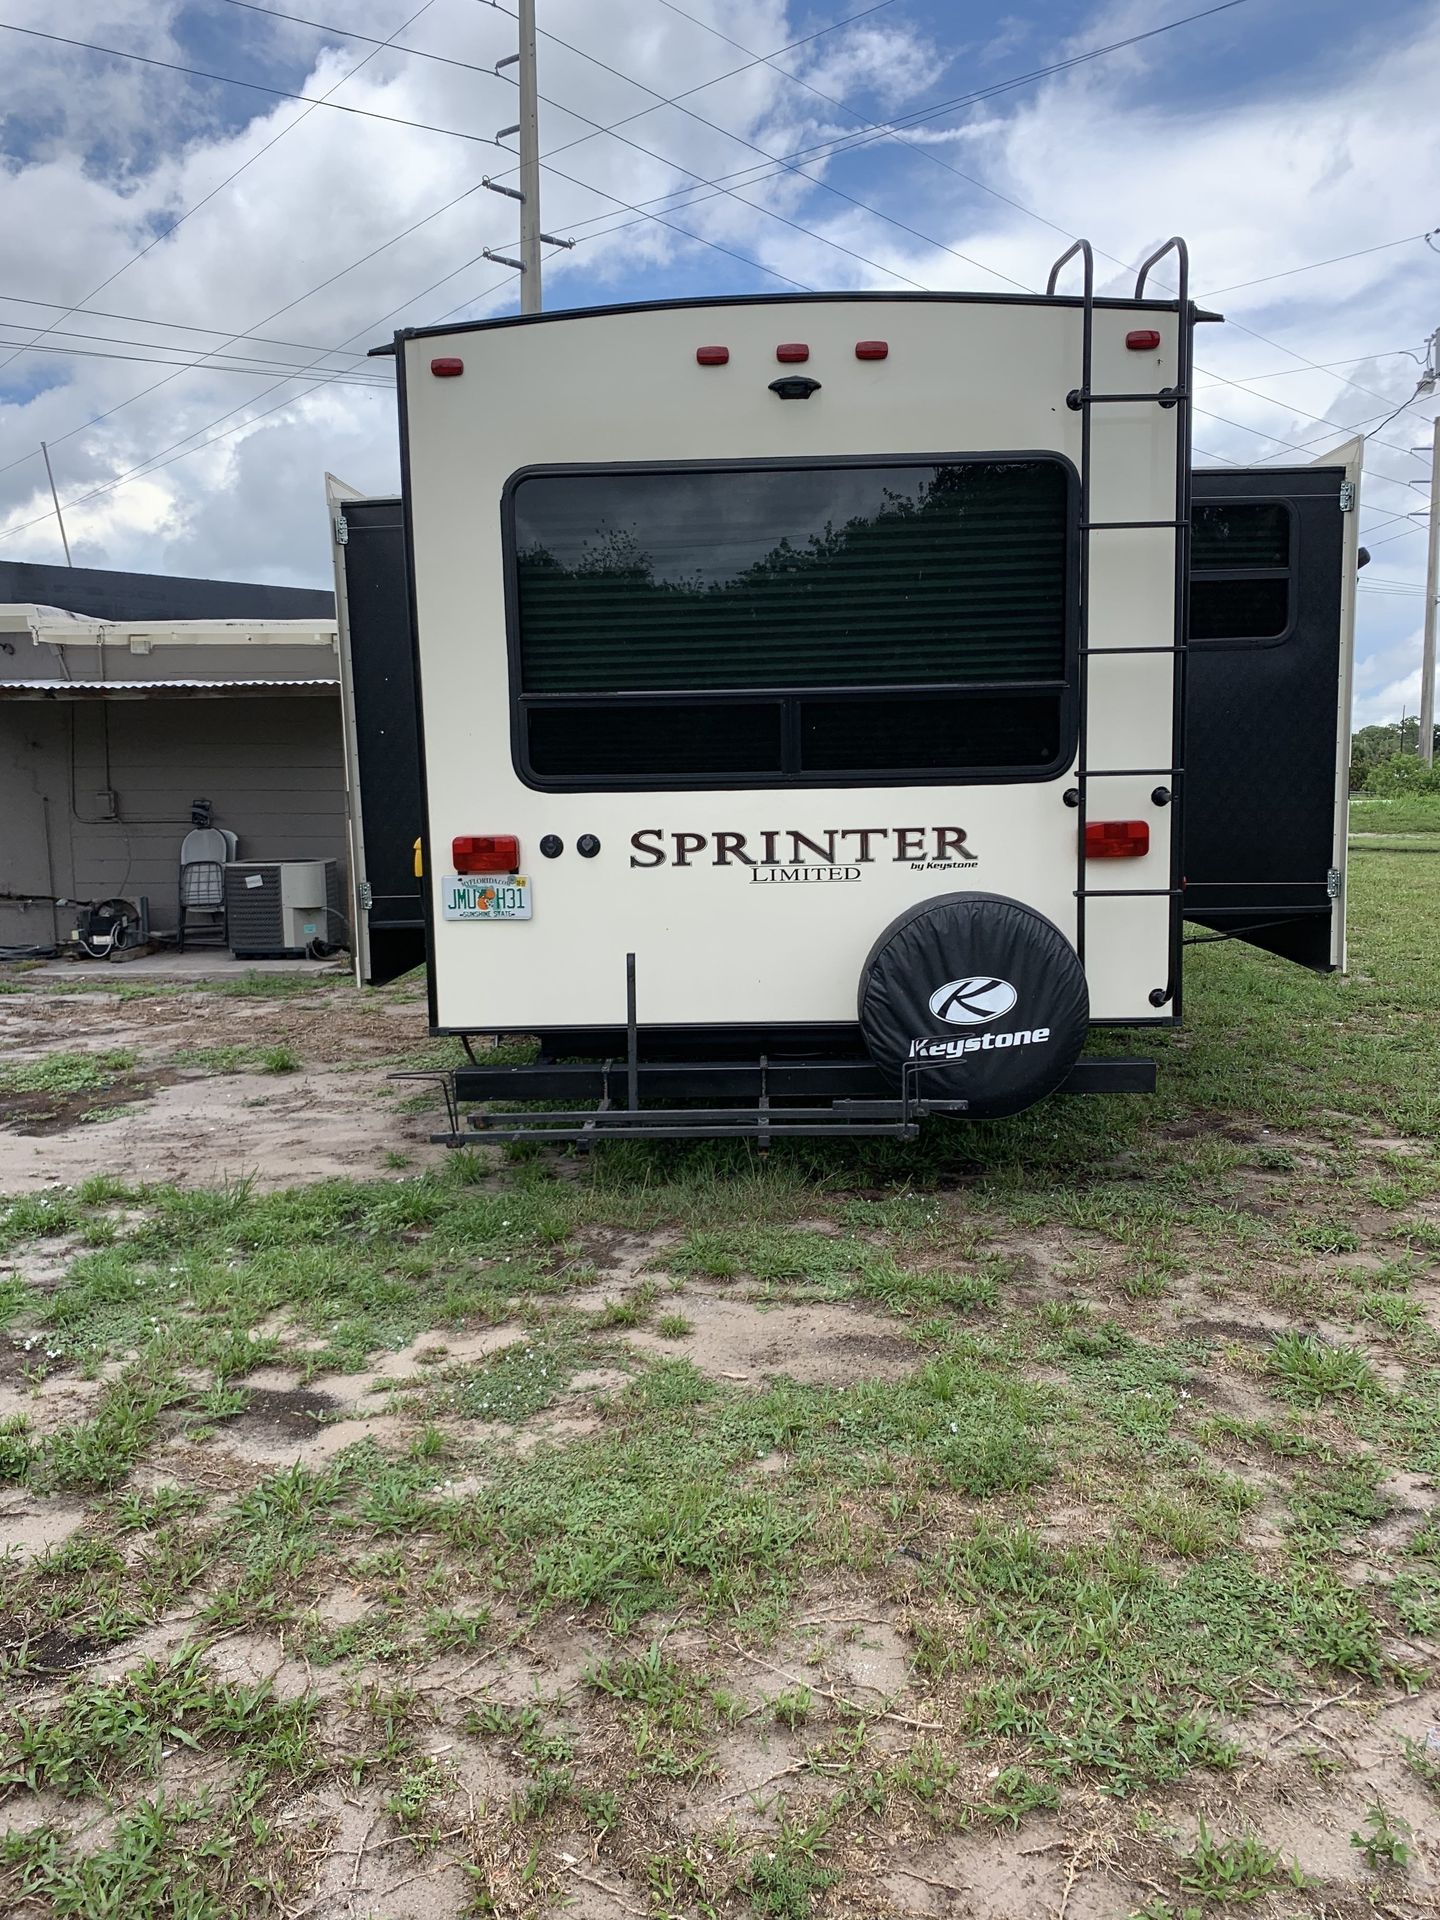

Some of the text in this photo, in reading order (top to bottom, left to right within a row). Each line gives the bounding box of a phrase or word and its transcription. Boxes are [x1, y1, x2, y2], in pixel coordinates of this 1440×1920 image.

[630, 827, 978, 868] SPRINTER
[751, 867, 862, 882] LIMITED
[910, 861, 978, 871] by Keystone
[448, 888, 525, 909] JMU H31
[909, 1027, 1050, 1059] Keystone
